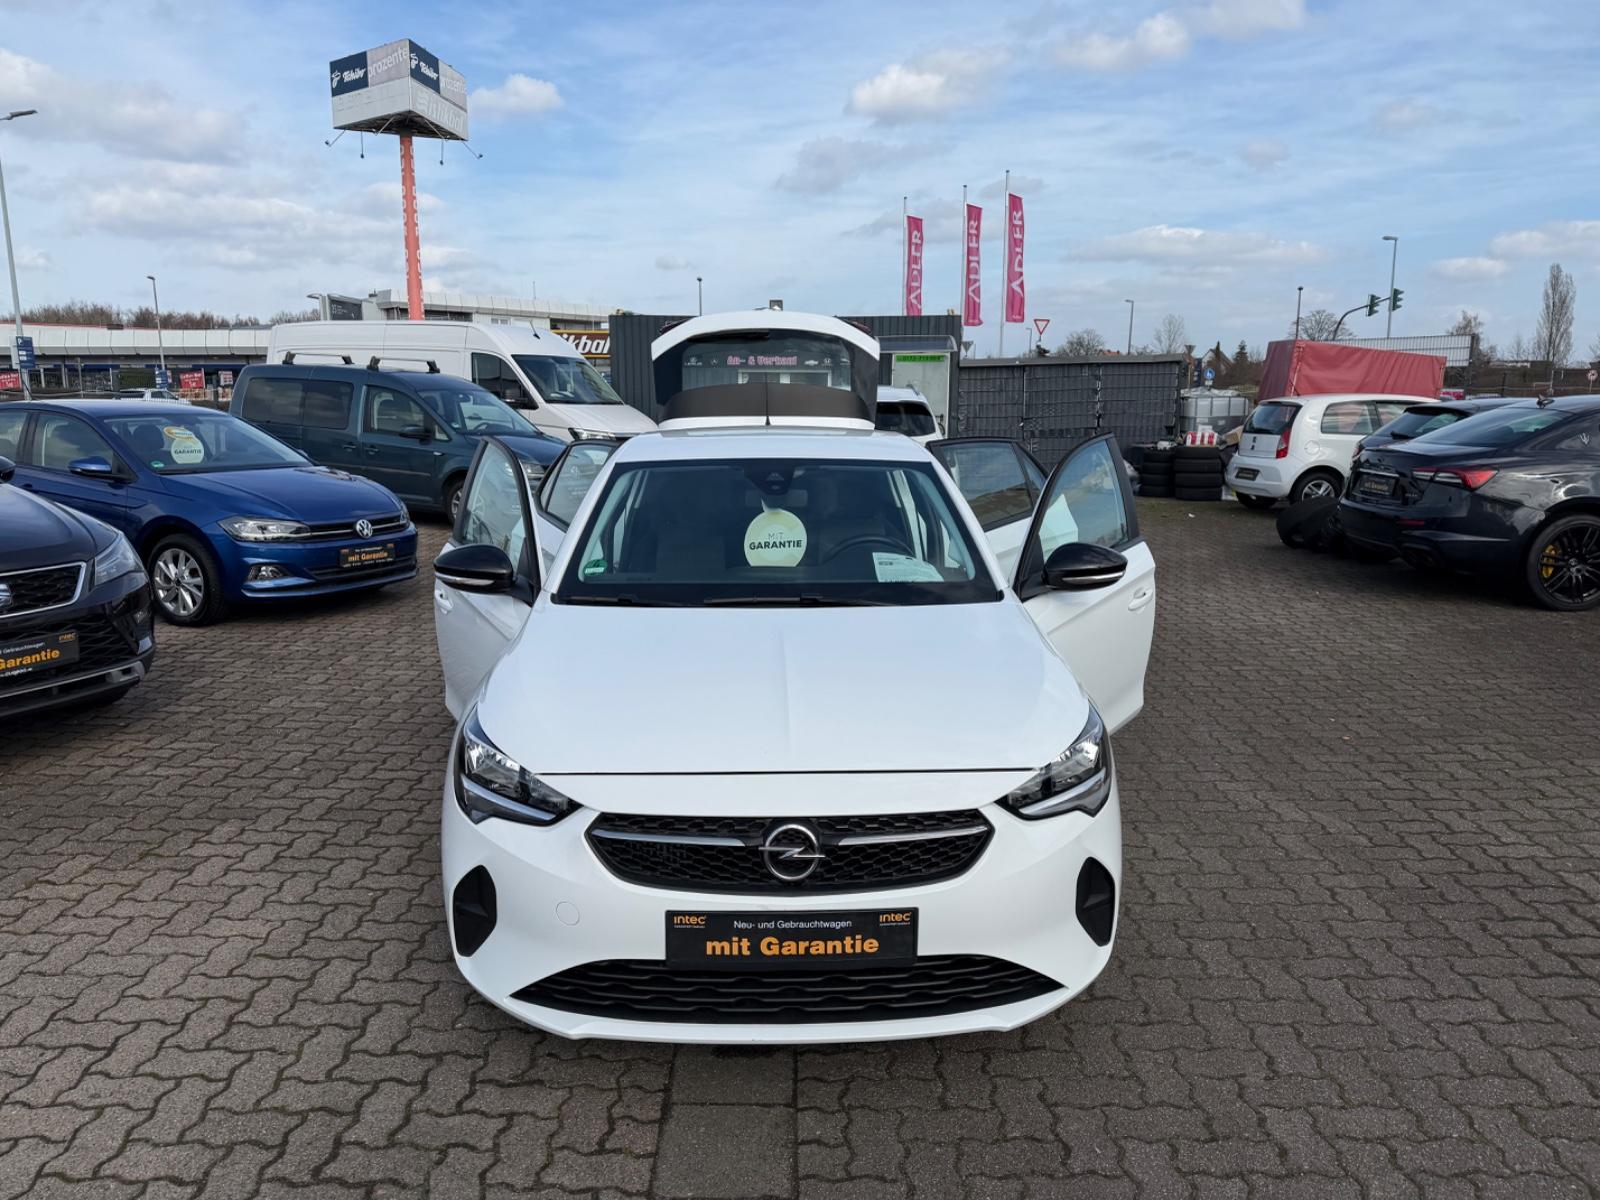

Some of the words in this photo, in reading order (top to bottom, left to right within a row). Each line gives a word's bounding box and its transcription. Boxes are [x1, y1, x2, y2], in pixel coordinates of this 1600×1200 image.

[968, 220, 980, 304] ADLER
[1010, 210, 1024, 298] ADLER
[909, 230, 921, 309] ADLER
[749, 539, 802, 551] GARANTIE
[673, 915, 706, 924] intec
[733, 920, 755, 929] Neu-
[757, 920, 775, 929] und
[777, 920, 852, 929] Gebrauchtwagen
[880, 912, 911, 922] intec
[706, 936, 751, 956] mit
[760, 934, 879, 956] Garantie
